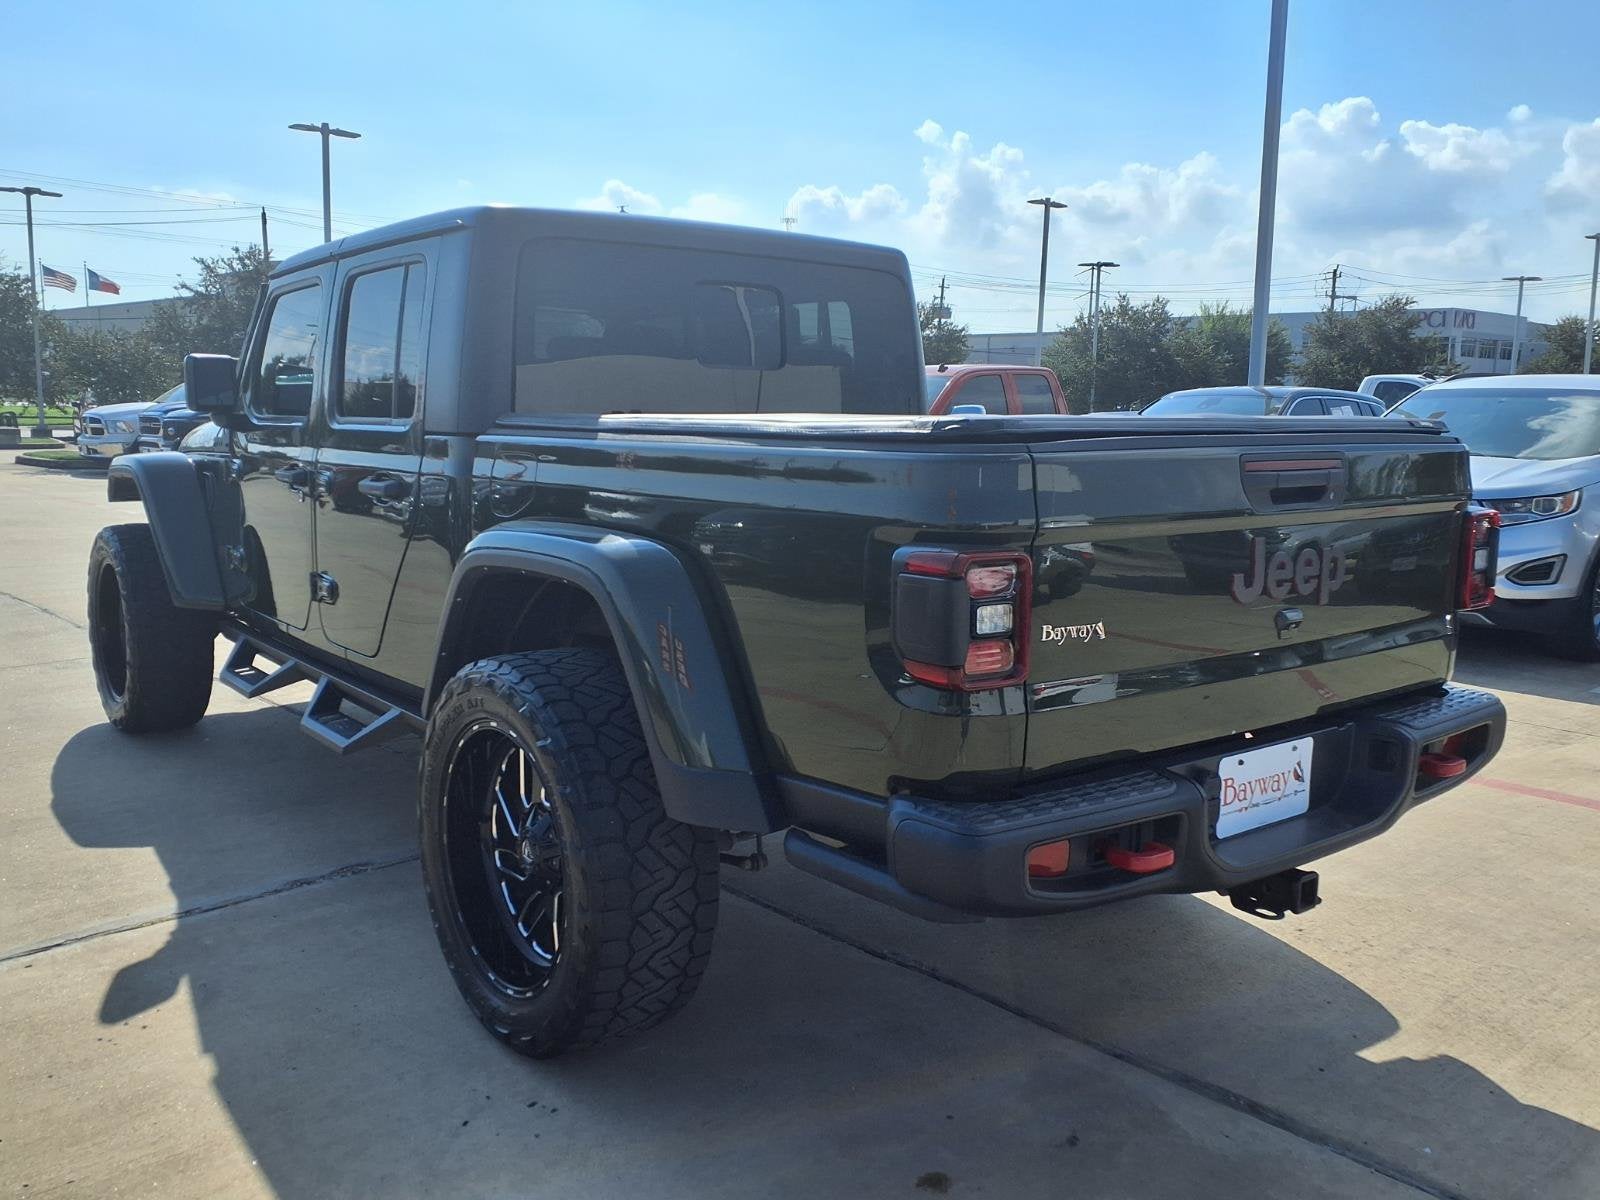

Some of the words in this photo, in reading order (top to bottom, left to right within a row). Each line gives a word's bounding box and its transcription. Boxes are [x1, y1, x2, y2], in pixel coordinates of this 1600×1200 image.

[1232, 537, 1345, 607] Jeep
[1041, 623, 1096, 646] Bayway
[1221, 769, 1291, 809] Bayway
